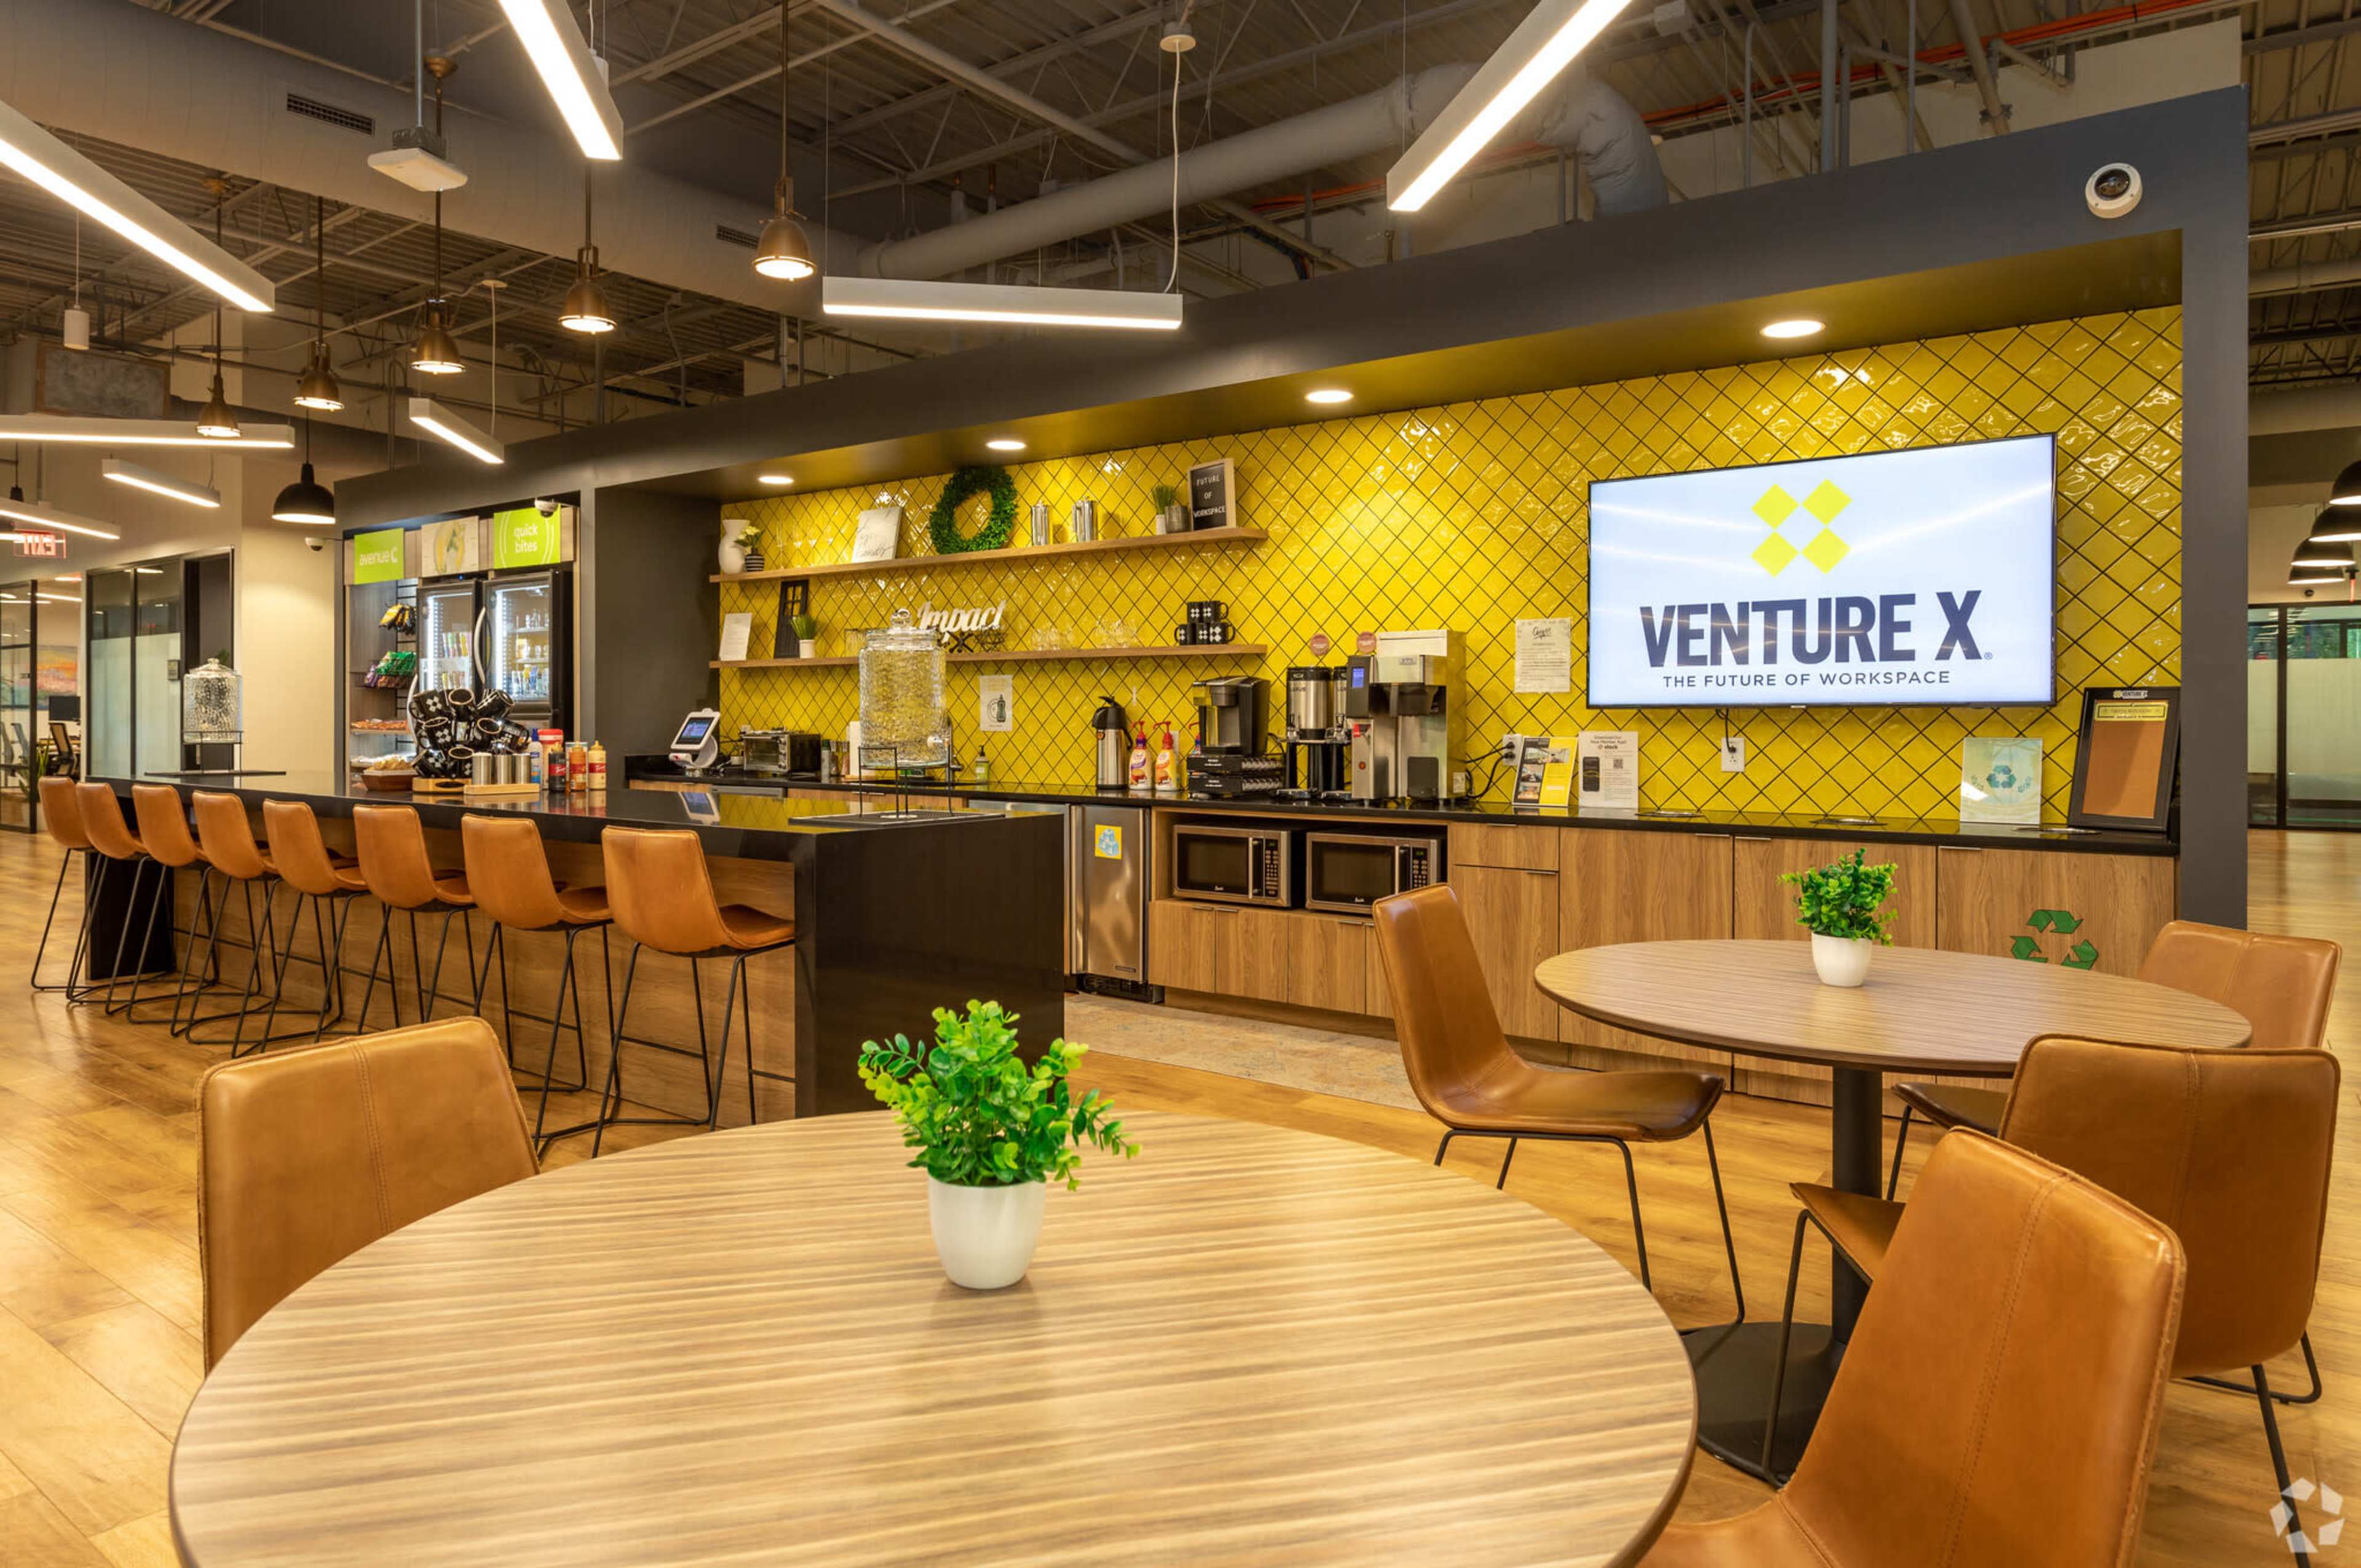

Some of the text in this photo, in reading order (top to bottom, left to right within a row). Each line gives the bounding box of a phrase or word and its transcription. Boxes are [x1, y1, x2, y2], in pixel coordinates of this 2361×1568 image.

[1196, 475, 1220, 486] FUTURE
[1193, 505, 1225, 518] WORKSPACE
[515, 523, 538, 541] quick
[515, 540, 537, 553] bites
[359, 546, 398, 566] avenue C
[917, 600, 1006, 643] Impact
[1640, 590, 1982, 667] VENTURE X
[1664, 671, 1949, 687] THE FUTURE OF WORKSPACE
